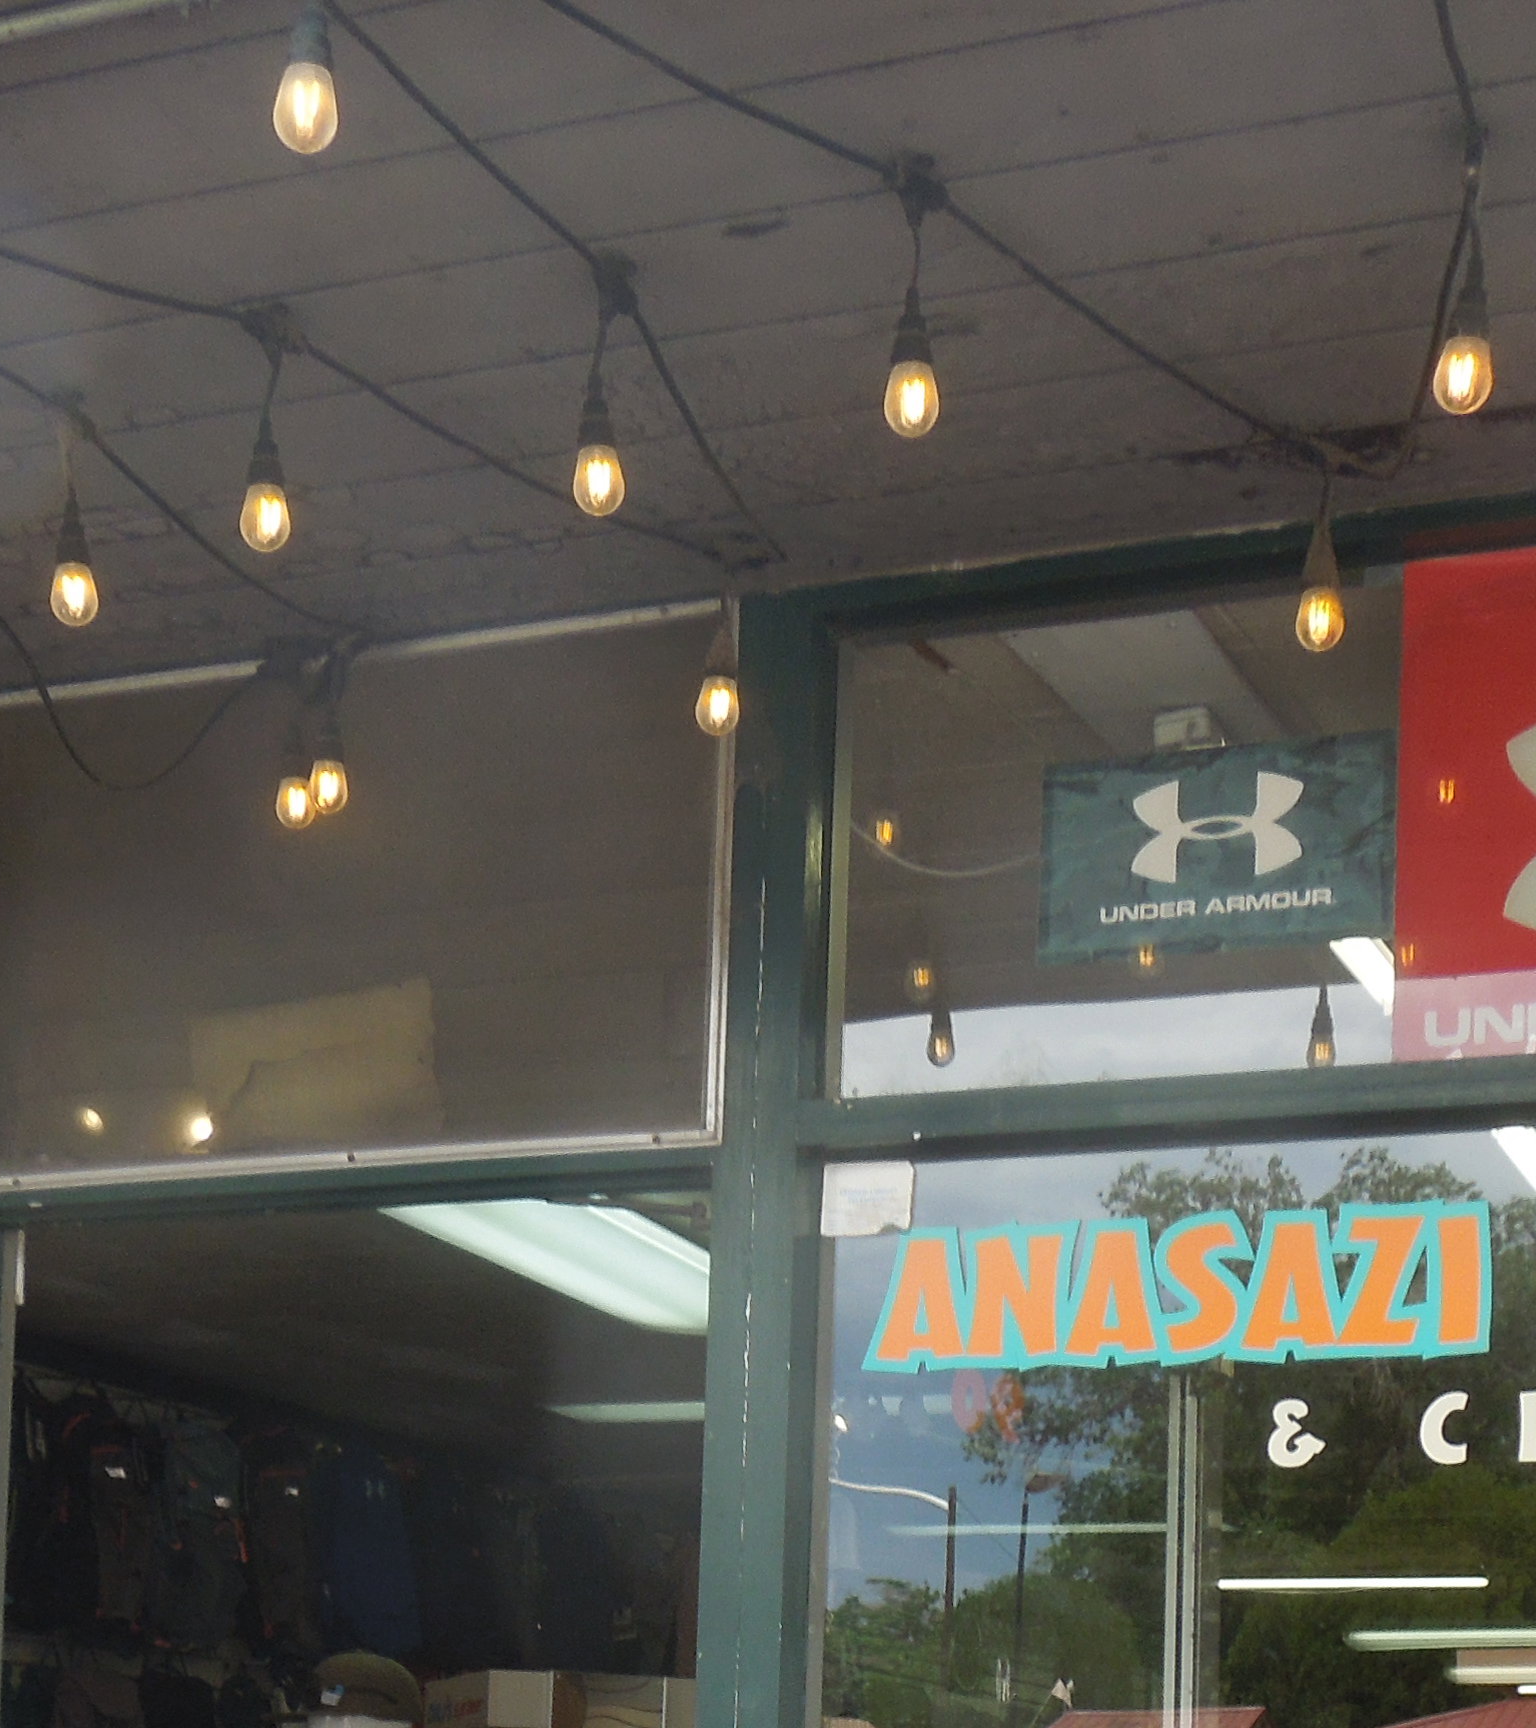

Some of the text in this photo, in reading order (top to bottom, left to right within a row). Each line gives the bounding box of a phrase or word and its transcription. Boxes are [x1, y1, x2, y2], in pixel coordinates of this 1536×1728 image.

[1099, 887, 1334, 924] UNDER ARMOUR
[862, 1199, 1492, 1374] ANASAZI
[1267, 1397, 1326, 1468] &
